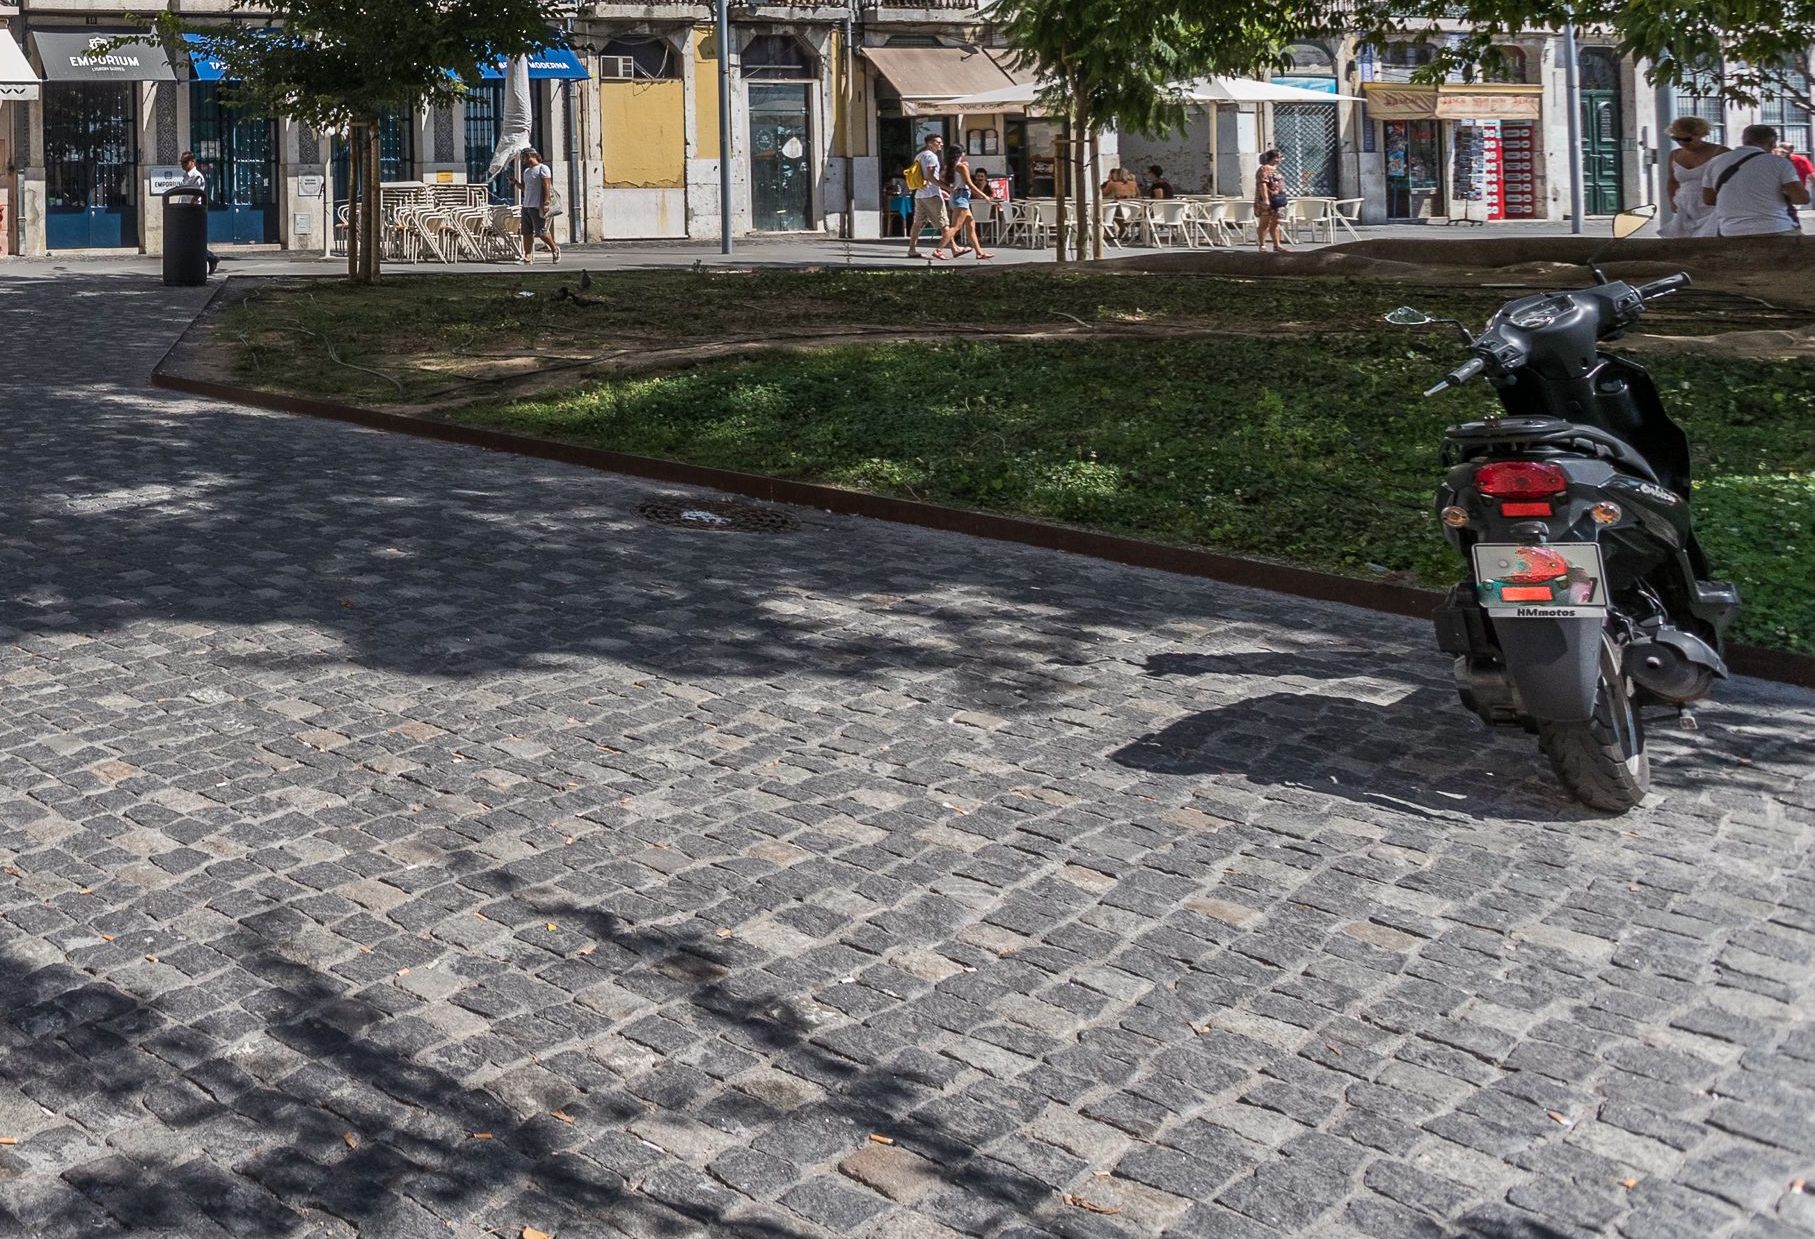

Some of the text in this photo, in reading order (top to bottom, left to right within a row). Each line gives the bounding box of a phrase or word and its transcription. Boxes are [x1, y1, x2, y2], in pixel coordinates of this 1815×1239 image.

[69, 56, 140, 67] EMPORIUM
[527, 61, 570, 70] MODERNA
[1517, 607, 1567, 618] HMmotos
